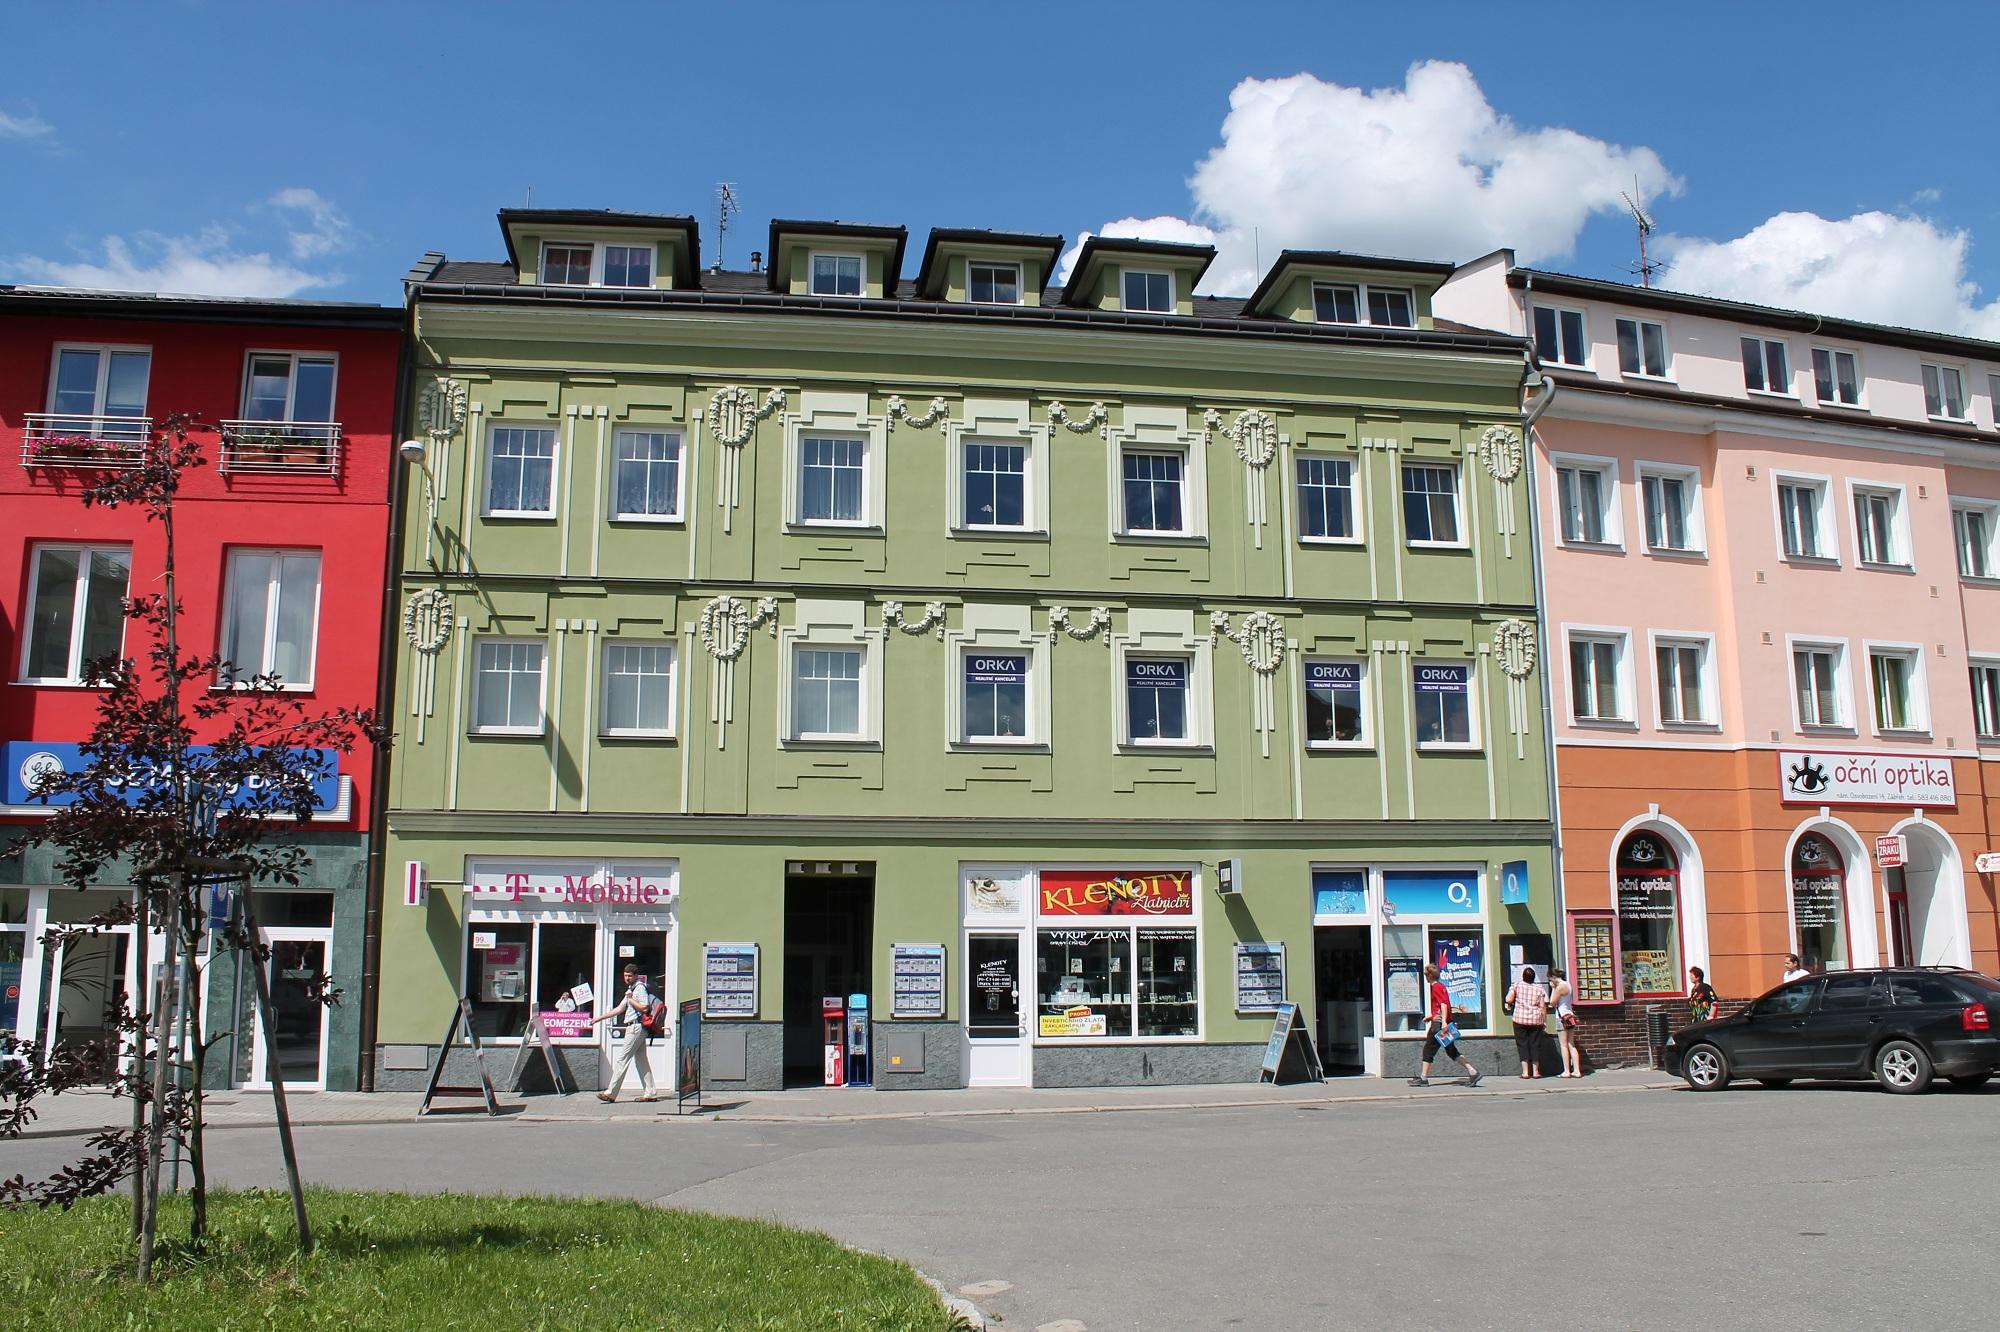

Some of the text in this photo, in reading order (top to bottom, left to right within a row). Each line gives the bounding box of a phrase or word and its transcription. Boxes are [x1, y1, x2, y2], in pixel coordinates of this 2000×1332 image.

[975, 659, 1016, 671] ORKA
[1136, 664, 1176, 676] ORKA
[1313, 666, 1352, 678] ORKA
[1421, 669, 1459, 680] ORKA
[1834, 758, 1951, 793] oční optika
[1878, 844, 1899, 856] ZRAKU
[1640, 877, 1673, 895] optika
[1809, 877, 1840, 894] optika
[1043, 872, 1190, 914] KLENOTY
[1050, 929, 1130, 943] VÝKUP ZLATA
